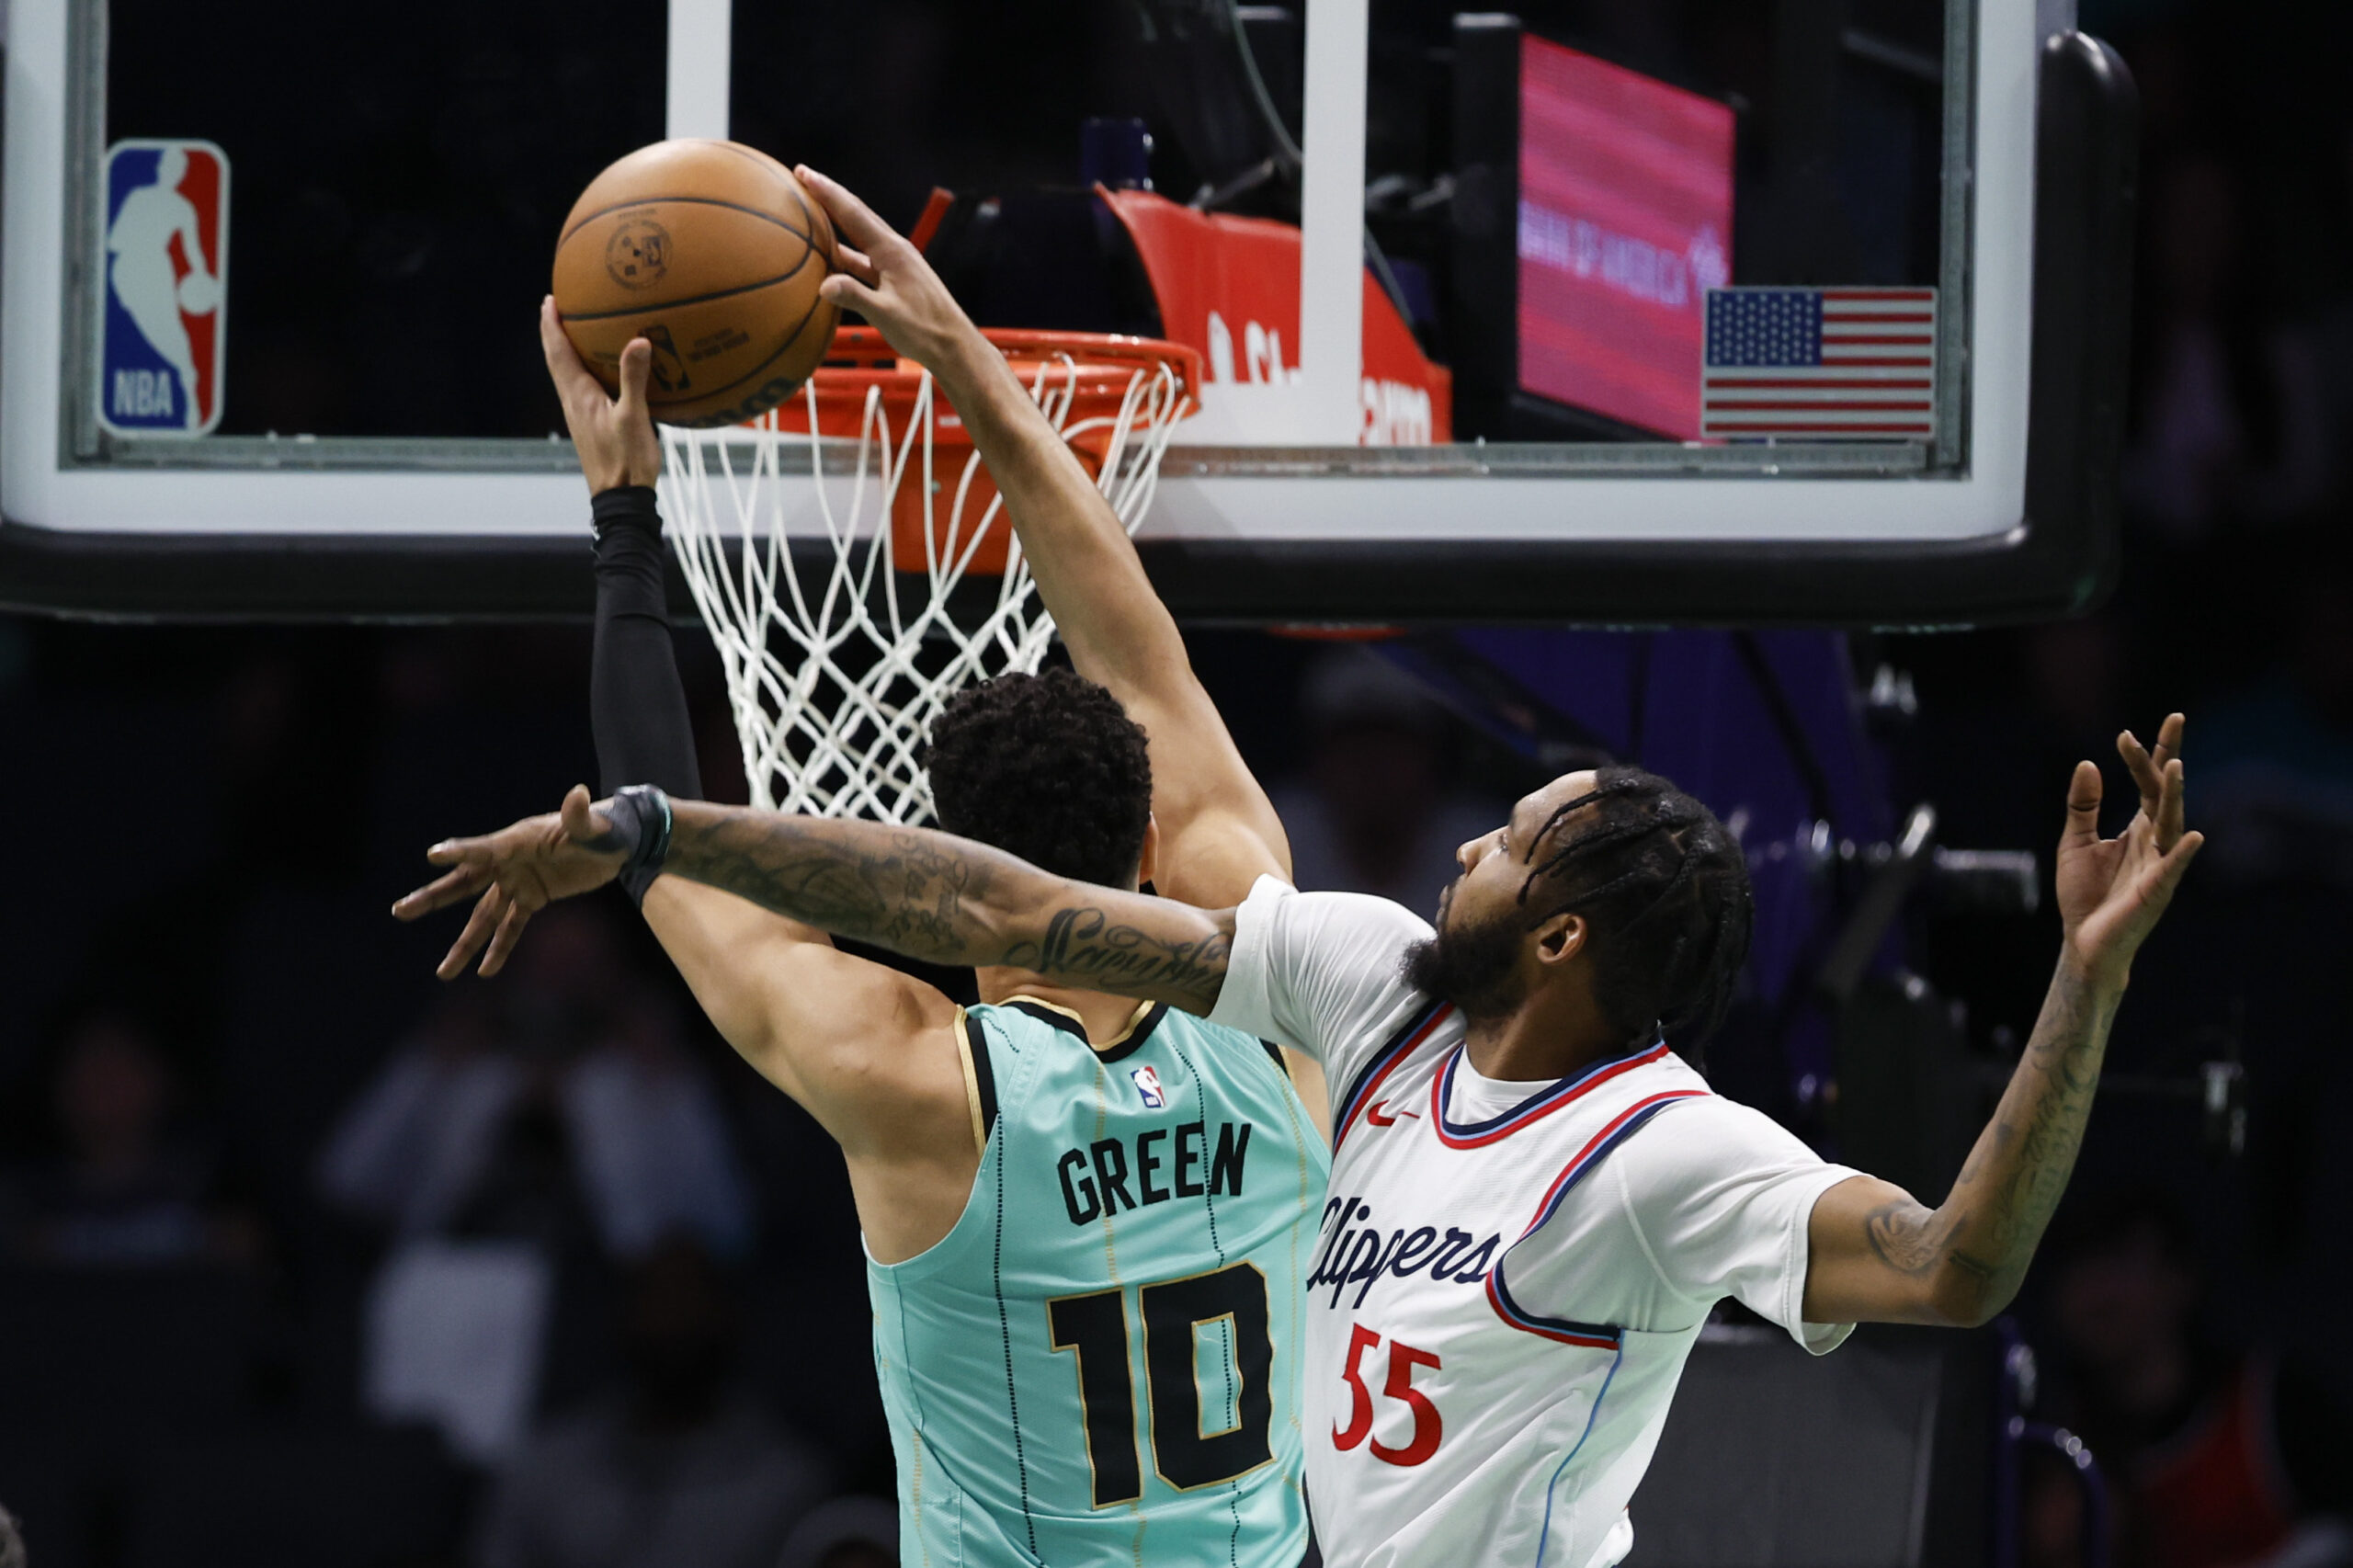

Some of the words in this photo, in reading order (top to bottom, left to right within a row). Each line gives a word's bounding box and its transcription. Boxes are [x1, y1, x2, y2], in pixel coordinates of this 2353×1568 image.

[114, 369, 174, 416] NBA
[1057, 1122, 1252, 1226] GREEN
[1046, 1259, 1277, 1511] 10
[1331, 1322, 1443, 1467] 55
